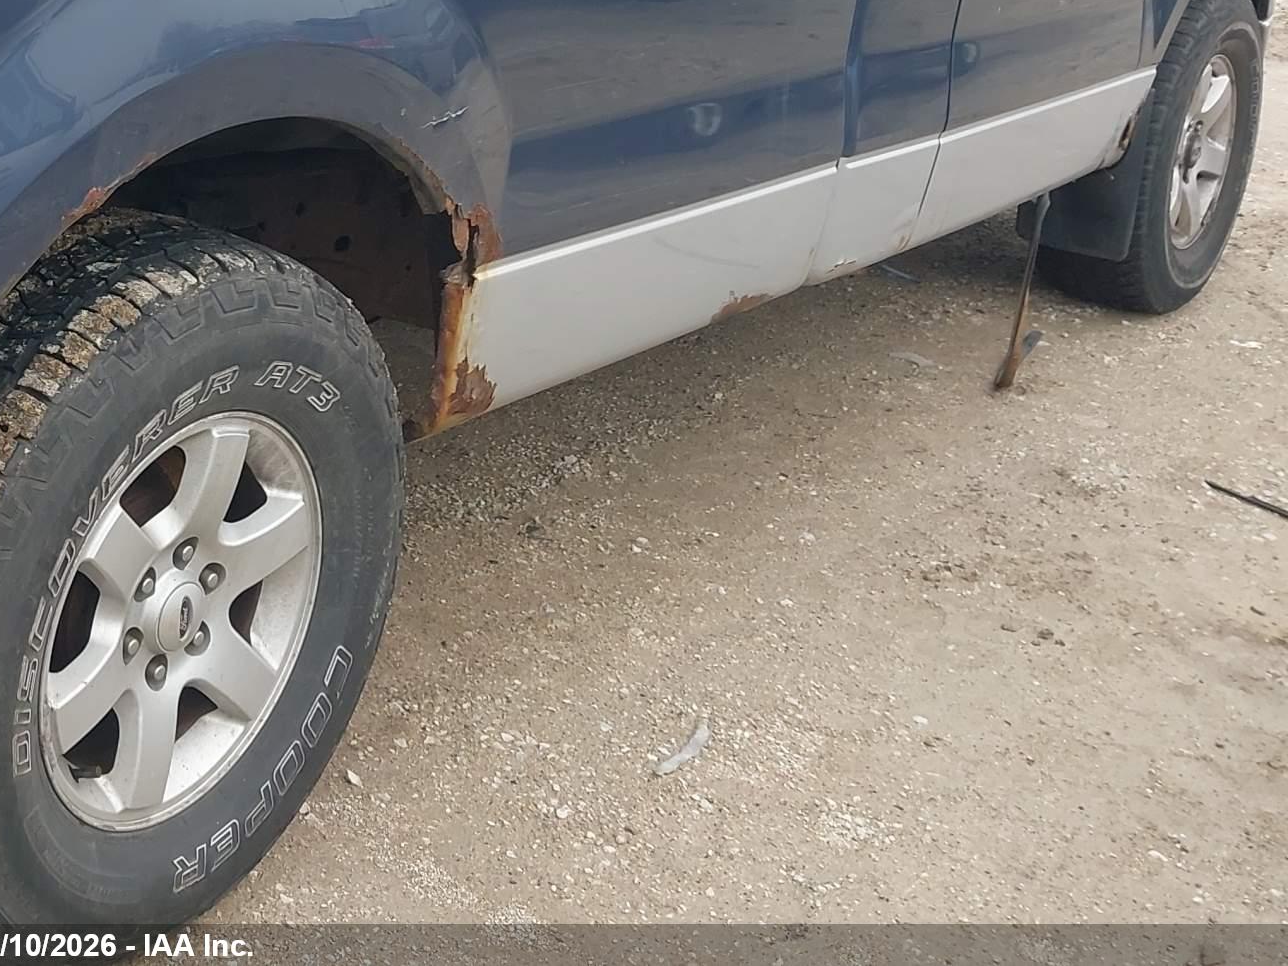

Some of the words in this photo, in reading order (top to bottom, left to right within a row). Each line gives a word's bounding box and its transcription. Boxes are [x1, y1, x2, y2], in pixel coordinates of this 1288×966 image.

[13, 364, 240, 777] DISCOVERER
[253, 360, 342, 413] AT3
[172, 644, 354, 894] COOPER
